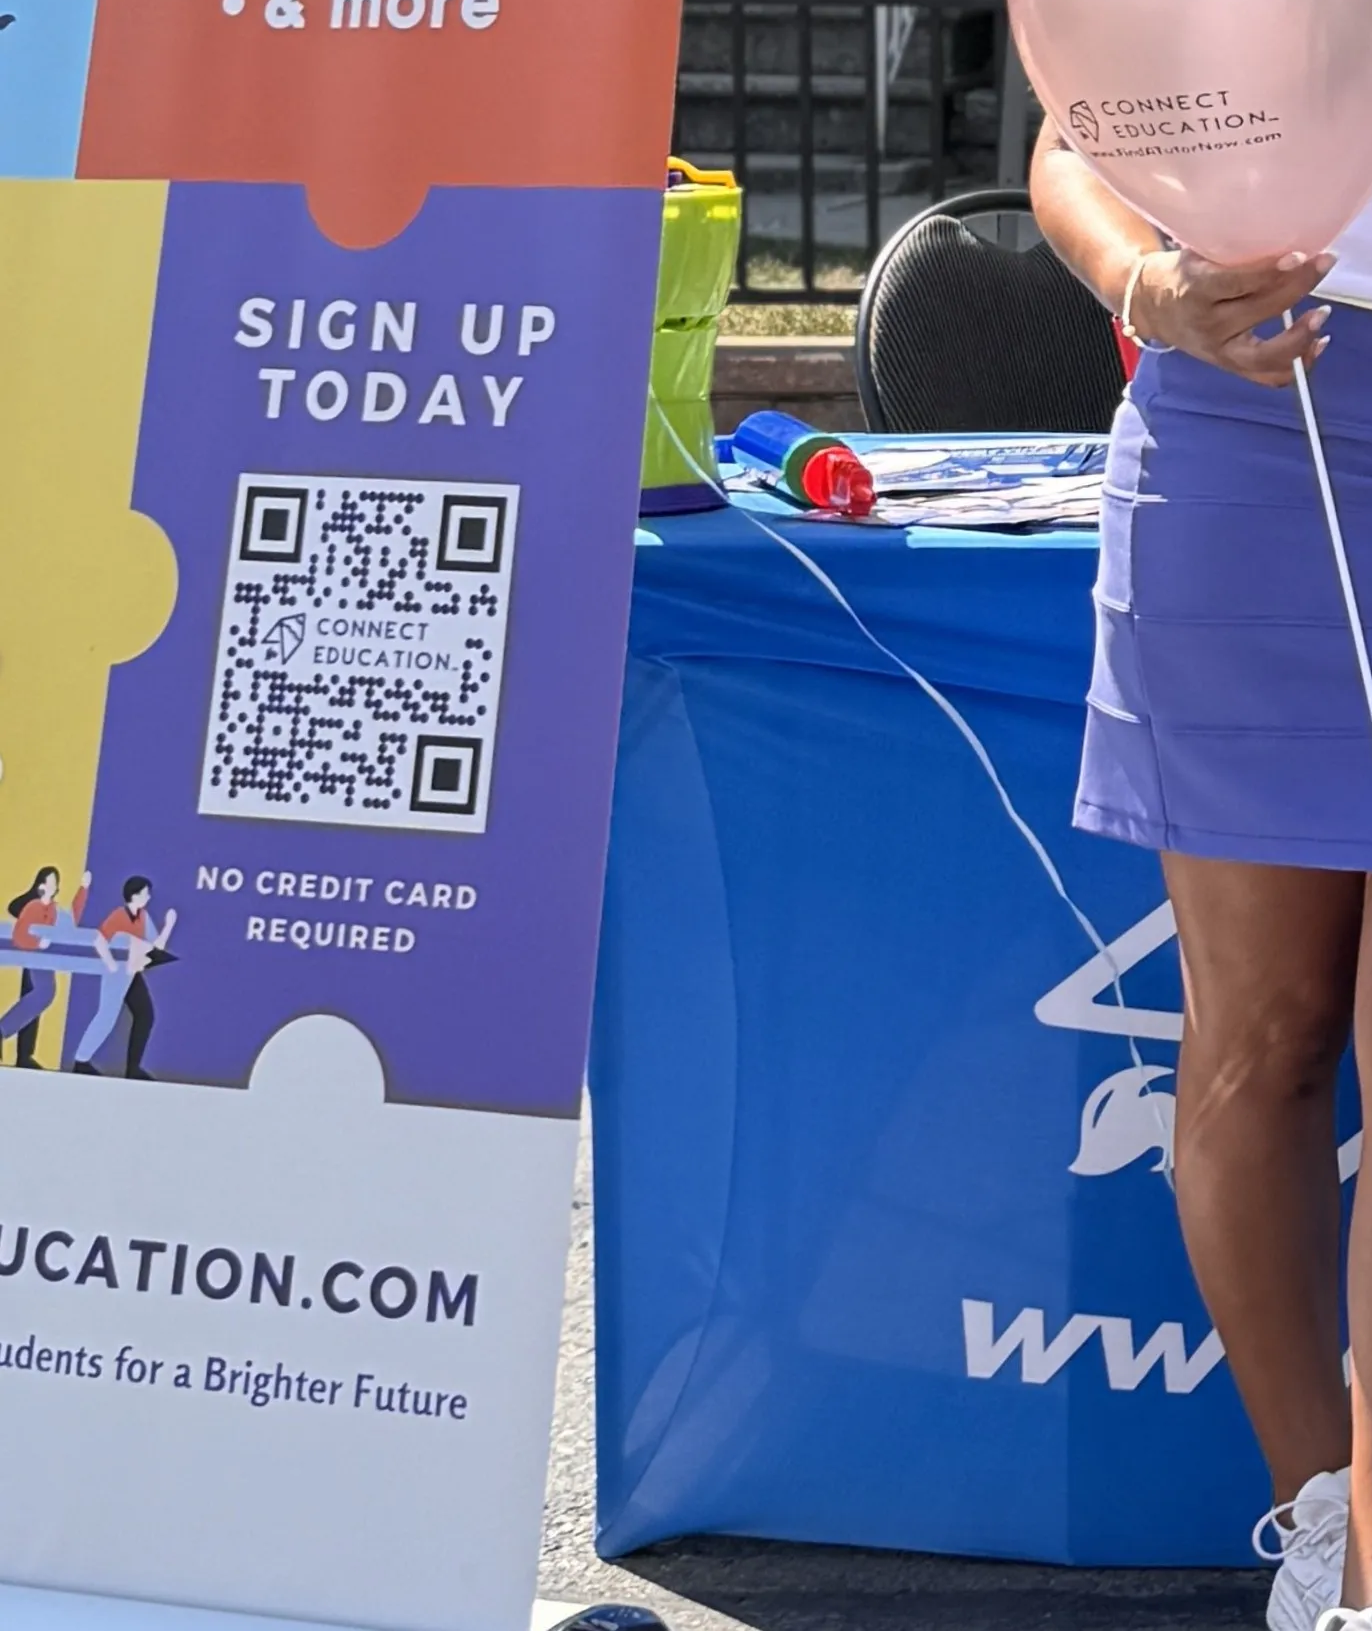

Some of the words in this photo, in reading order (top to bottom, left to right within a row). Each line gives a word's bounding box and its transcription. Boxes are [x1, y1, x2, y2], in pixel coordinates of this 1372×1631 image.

[1101, 91, 1230, 116] CONNECT
[234, 297, 416, 353] SIGN
[461, 304, 557, 356] UP
[258, 368, 524, 427] TODAY
[317, 618, 429, 641] CONNECT
[196, 865, 244, 893] NO
[255, 869, 374, 904] CREDIT
[385, 878, 478, 911] CARD
[246, 916, 416, 953] REQUIRED
[0, 1225, 479, 1328] UCATION.COM
[0, 1336, 102, 1379] udents
[114, 1345, 164, 1385] for
[173, 1362, 192, 1390] a
[203, 1357, 342, 1409] Brighter
[354, 1373, 468, 1420] Future
